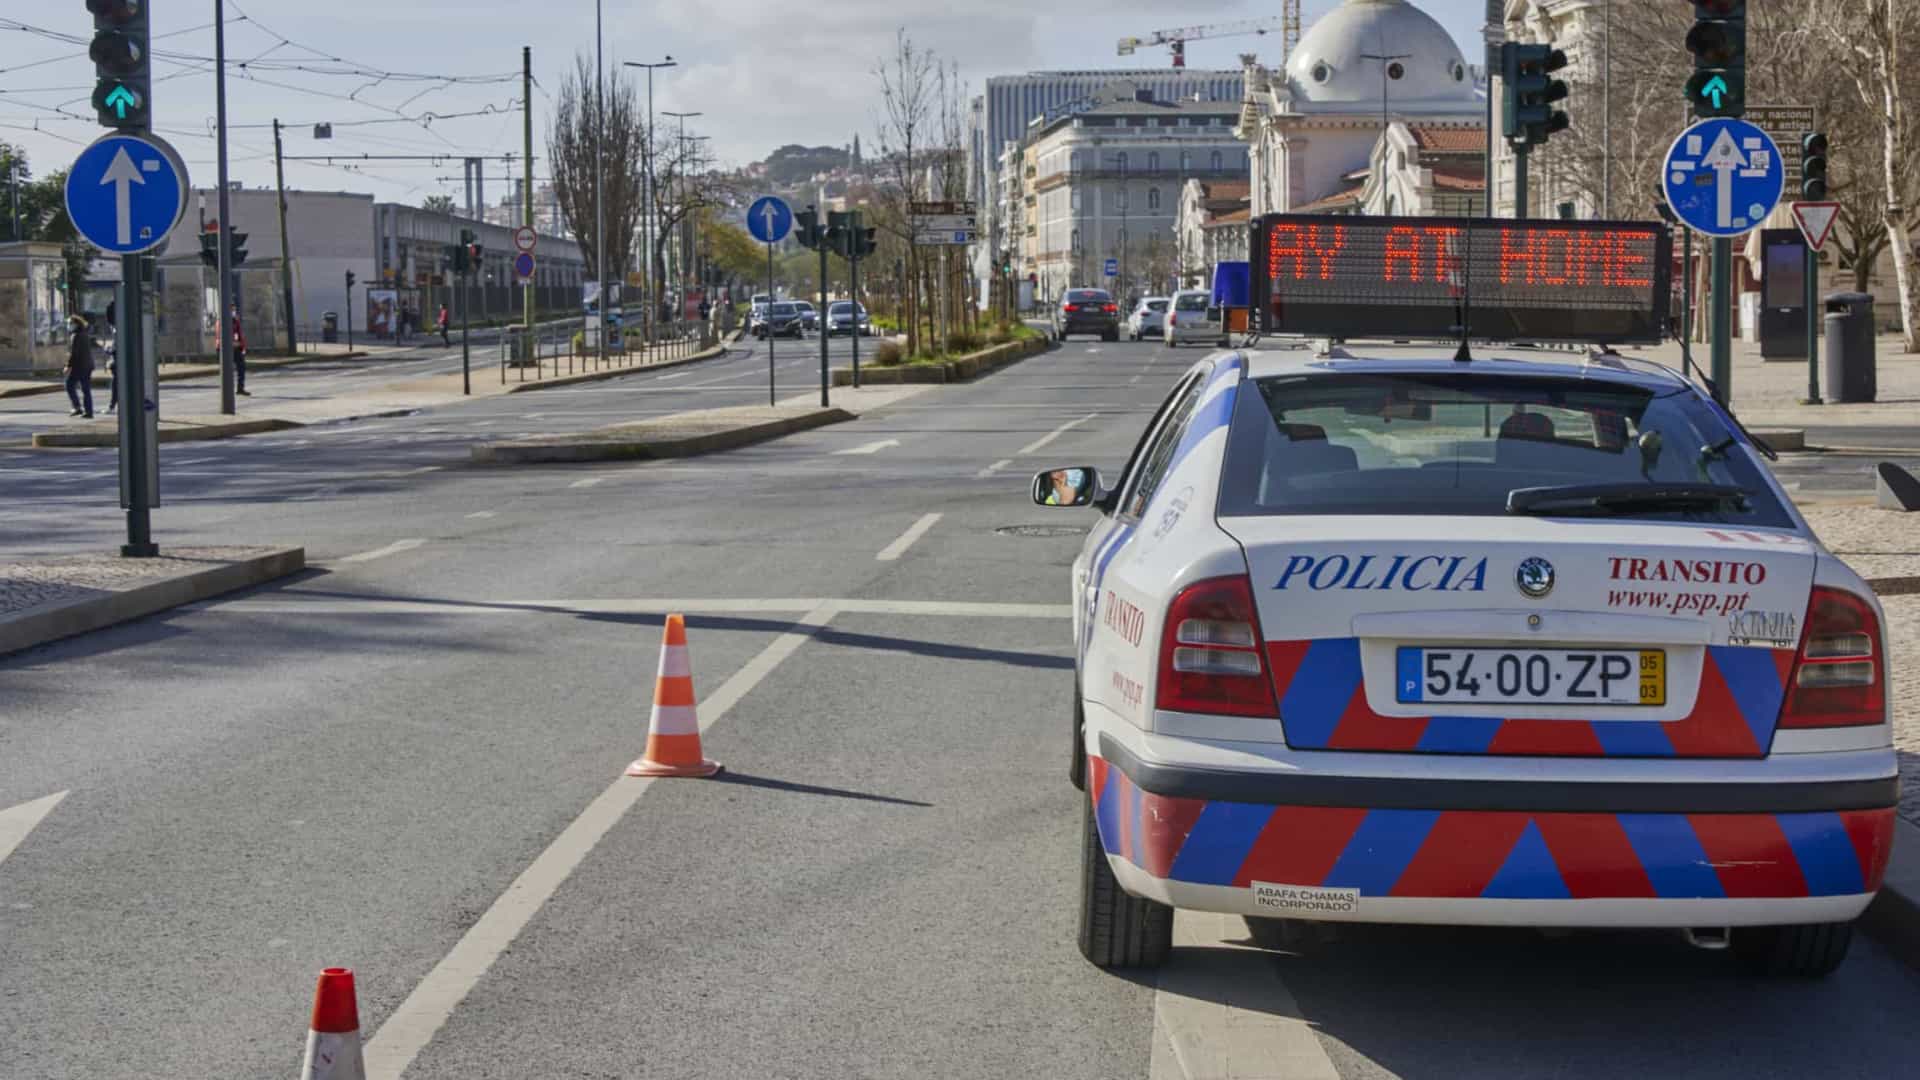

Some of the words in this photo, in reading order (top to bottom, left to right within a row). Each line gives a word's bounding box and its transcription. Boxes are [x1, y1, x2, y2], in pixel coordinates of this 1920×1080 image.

[1743, 110, 1764, 119] seu
[1767, 109, 1812, 119] nacional
[1270, 223, 1344, 281] AY
[1384, 225, 1459, 282] AT
[1500, 228, 1652, 287] HOME
[1271, 554, 1489, 592] POLICIA
[1608, 557, 1767, 585] TRANSITO
[1607, 589, 1751, 617] www.psp.pt
[1104, 590, 1145, 648] TRANSITO
[1640, 655, 1657, 670] 05
[1405, 680, 1417, 694] P
[1640, 684, 1657, 698] 03
[1257, 886, 1297, 899] ABAFA
[1300, 889, 1355, 903] CHAMAS
[1257, 896, 1353, 912] INCORPORADO
